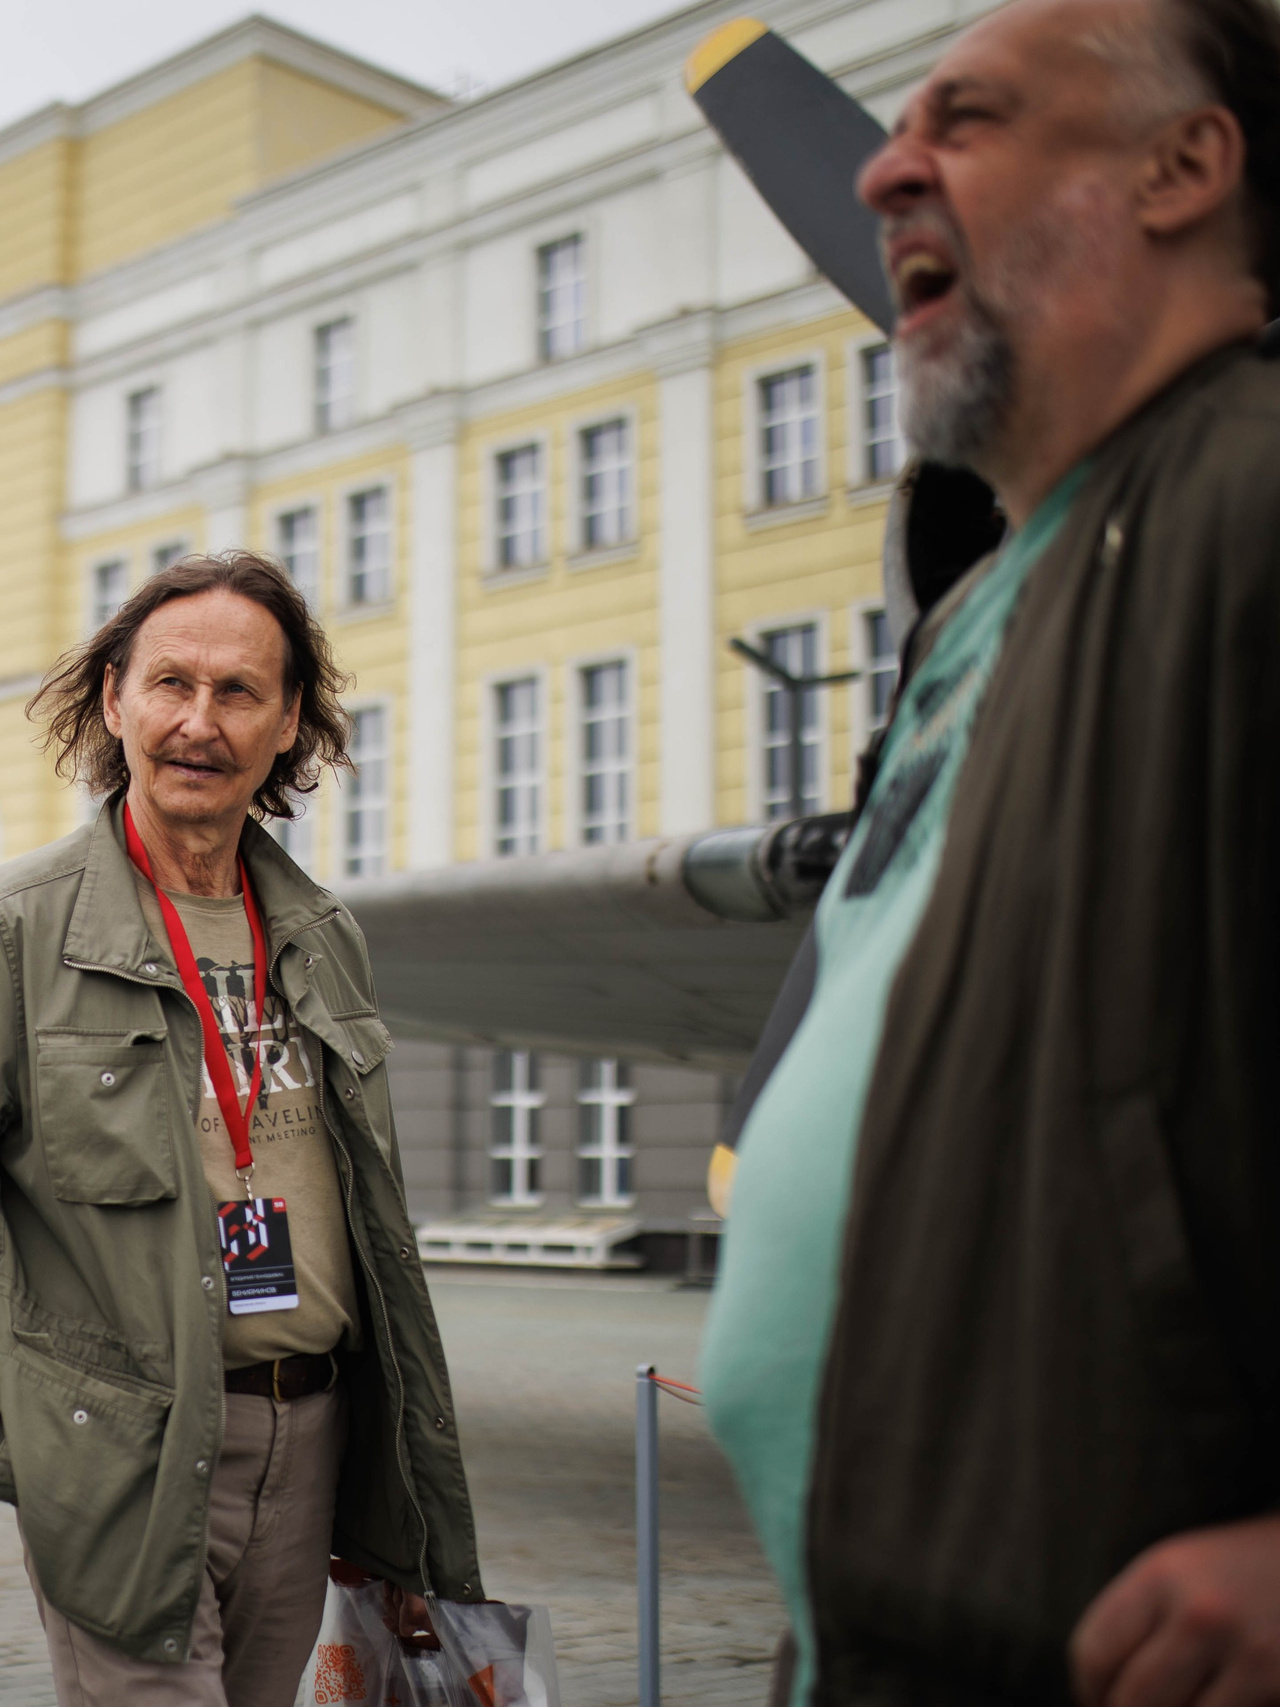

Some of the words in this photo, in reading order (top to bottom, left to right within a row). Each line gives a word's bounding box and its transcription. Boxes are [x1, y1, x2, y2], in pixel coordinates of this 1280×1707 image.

[200, 1117, 220, 1133] OF
[252, 1105, 323, 1130] AVELIN
[266, 1126, 317, 1142] MEETING
